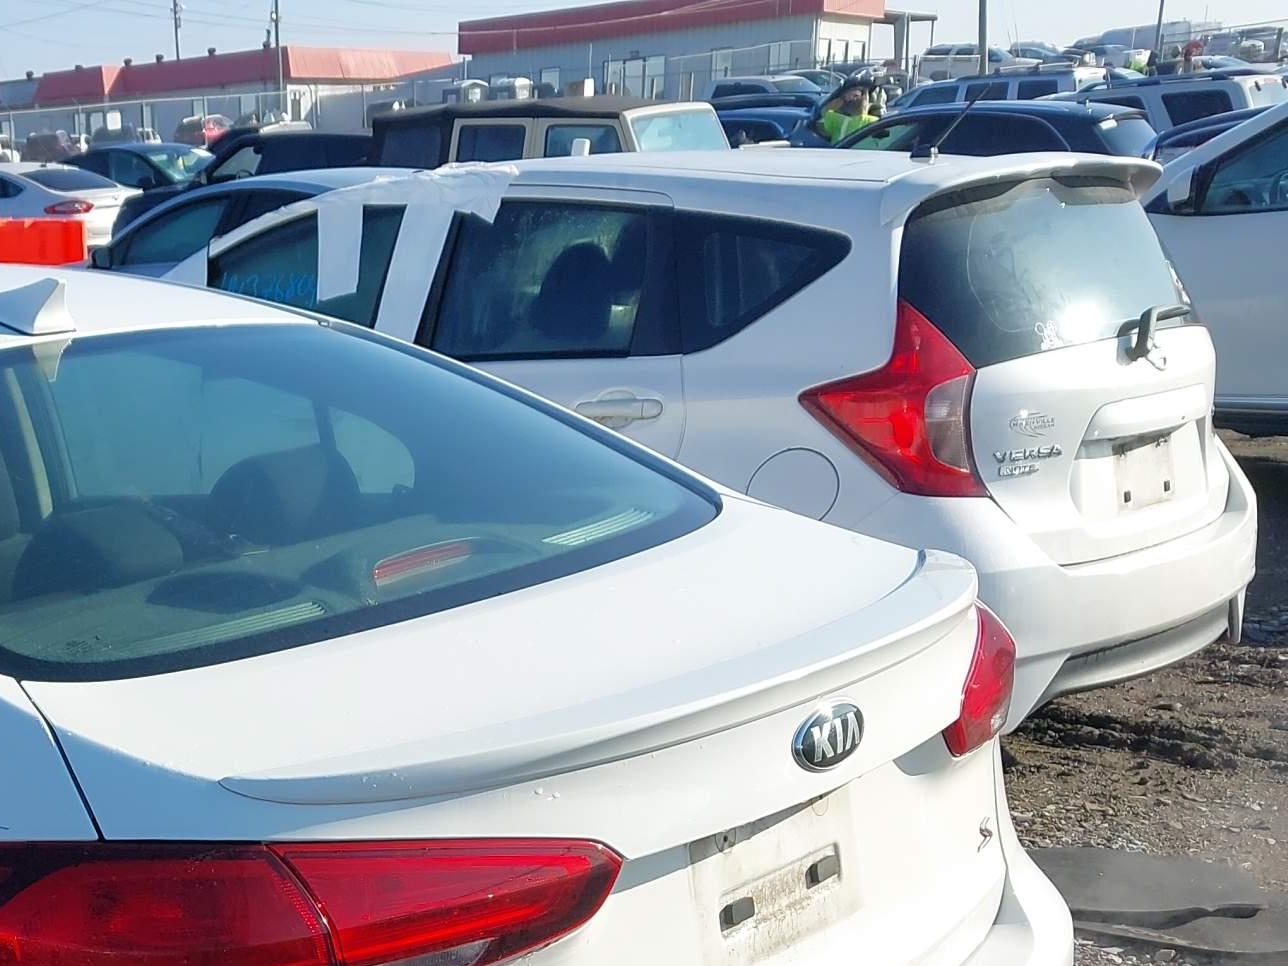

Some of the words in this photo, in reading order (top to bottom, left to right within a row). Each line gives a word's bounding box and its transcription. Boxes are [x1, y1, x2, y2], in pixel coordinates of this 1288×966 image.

[992, 444, 1063, 463] VERSA
[998, 463, 1040, 477] NOTE
[810, 710, 861, 763] KIA
